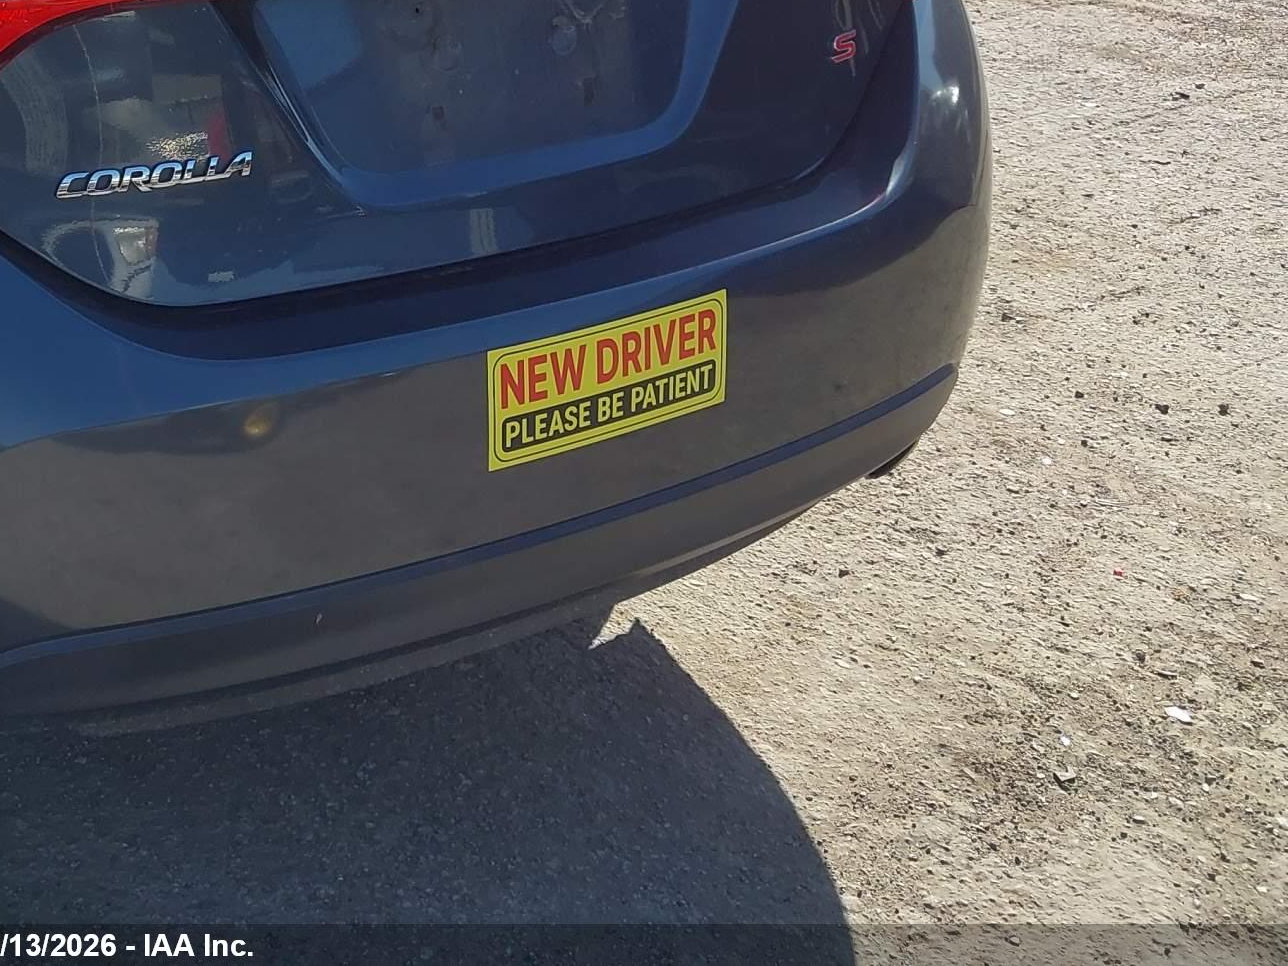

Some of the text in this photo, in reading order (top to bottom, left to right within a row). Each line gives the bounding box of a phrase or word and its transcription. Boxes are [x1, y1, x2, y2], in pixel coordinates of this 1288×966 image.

[831, 28, 857, 64] S
[55, 150, 254, 200] COROLLA
[499, 309, 716, 409] NEW DRIVER
[504, 364, 714, 449] PLEASE BE PATIENT
